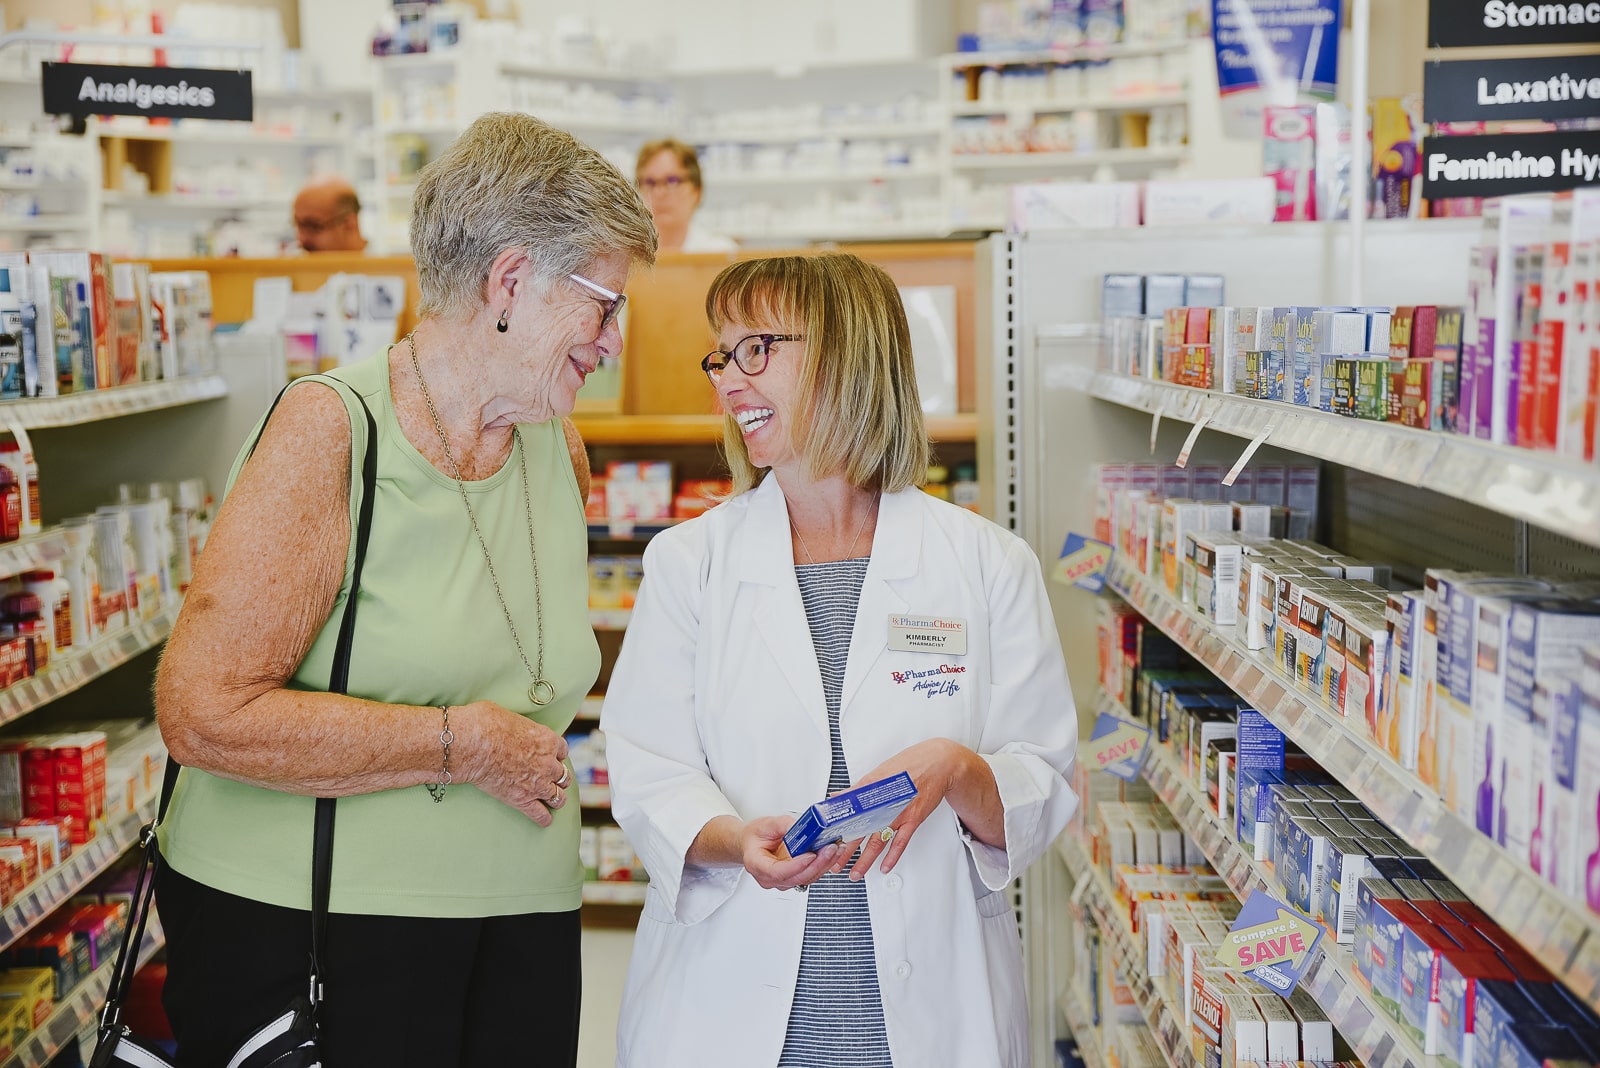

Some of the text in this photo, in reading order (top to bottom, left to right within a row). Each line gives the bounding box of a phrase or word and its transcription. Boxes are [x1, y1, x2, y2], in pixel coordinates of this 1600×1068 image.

[1483, 0, 1600, 28] Stomac
[78, 76, 216, 109] Analgesics
[1428, 148, 1600, 182] Feminine Hy
[906, 634, 947, 642] KIMBERLY
[913, 680, 941, 692] Advice
[927, 679, 960, 698] for Life
[1096, 737, 1141, 766] SAVE
[1232, 920, 1298, 944] Compare &
[1237, 931, 1306, 966] SAVE
[1193, 985, 1220, 1030] TYLENOL
